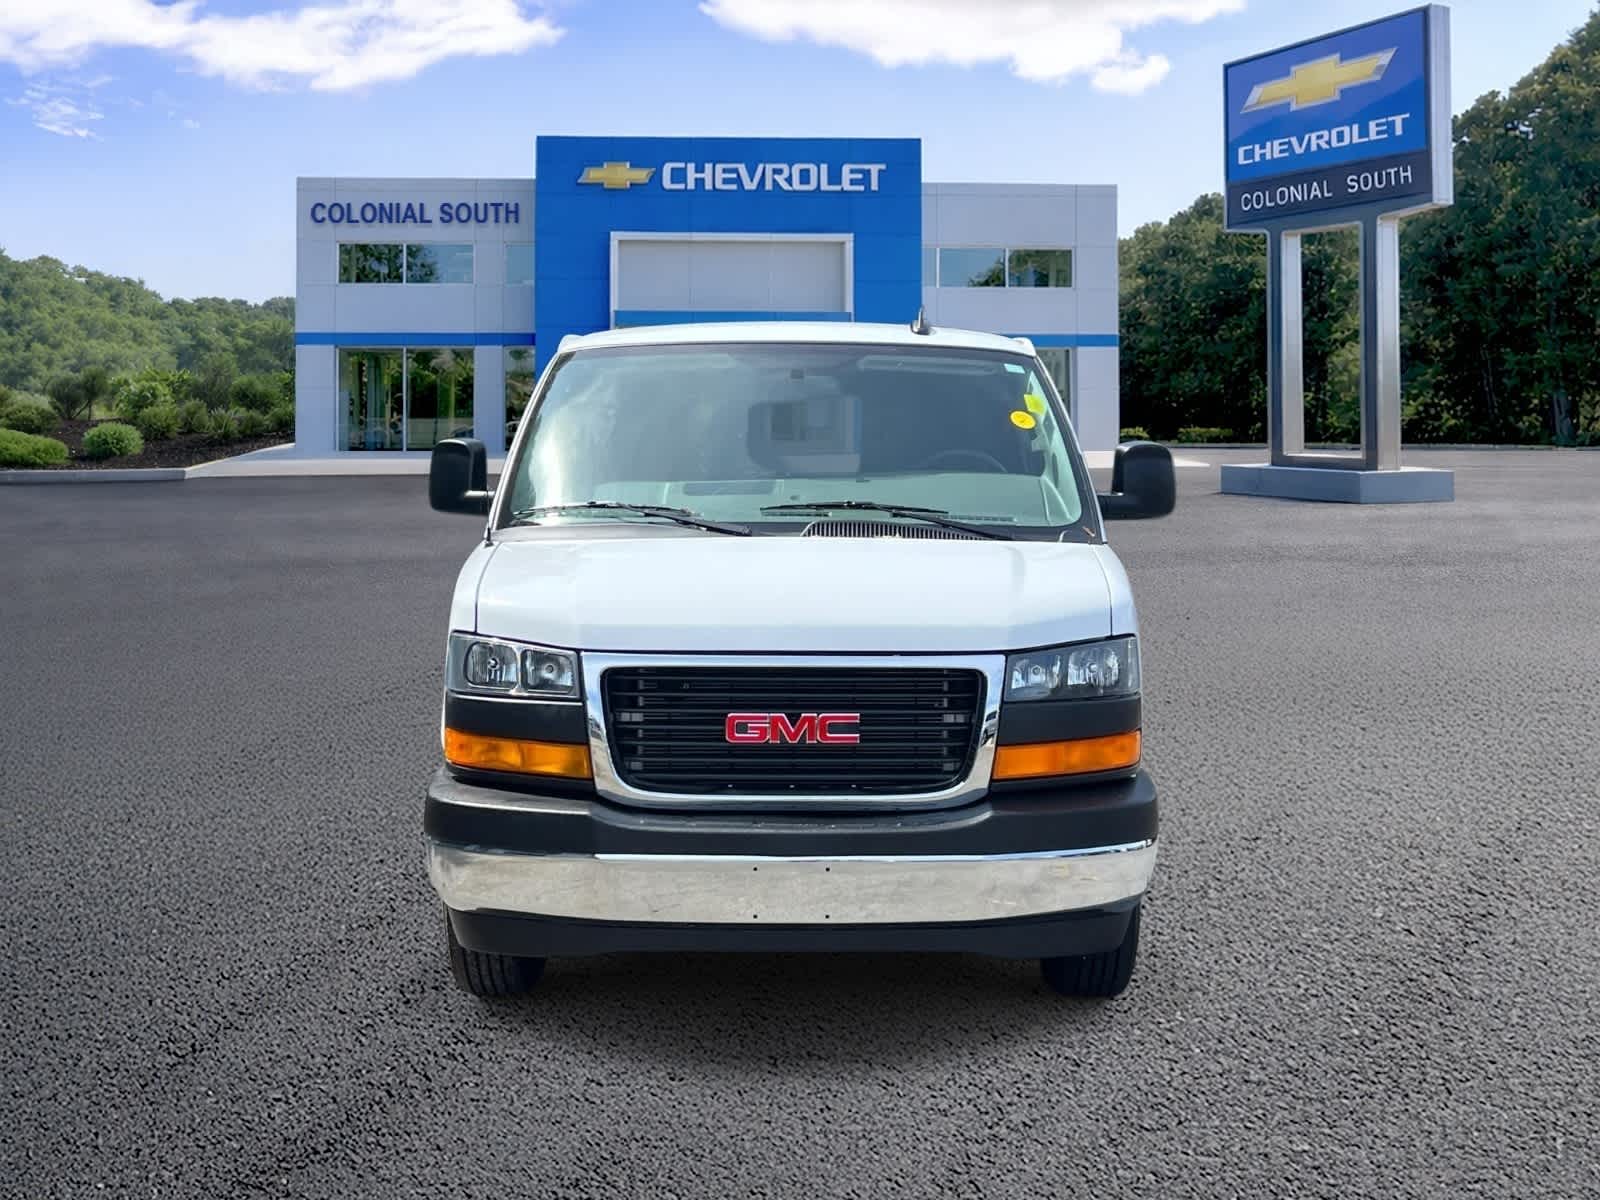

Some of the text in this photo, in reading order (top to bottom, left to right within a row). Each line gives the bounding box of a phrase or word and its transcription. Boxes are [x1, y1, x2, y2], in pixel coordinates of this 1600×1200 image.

[1237, 113, 1410, 165] CHEVROLET
[661, 162, 887, 192] CHEVROLET
[1241, 165, 1413, 211] COLONIAL SOUTH
[310, 202, 520, 225] COLONIAL SOUTH
[725, 713, 860, 743] GMC
